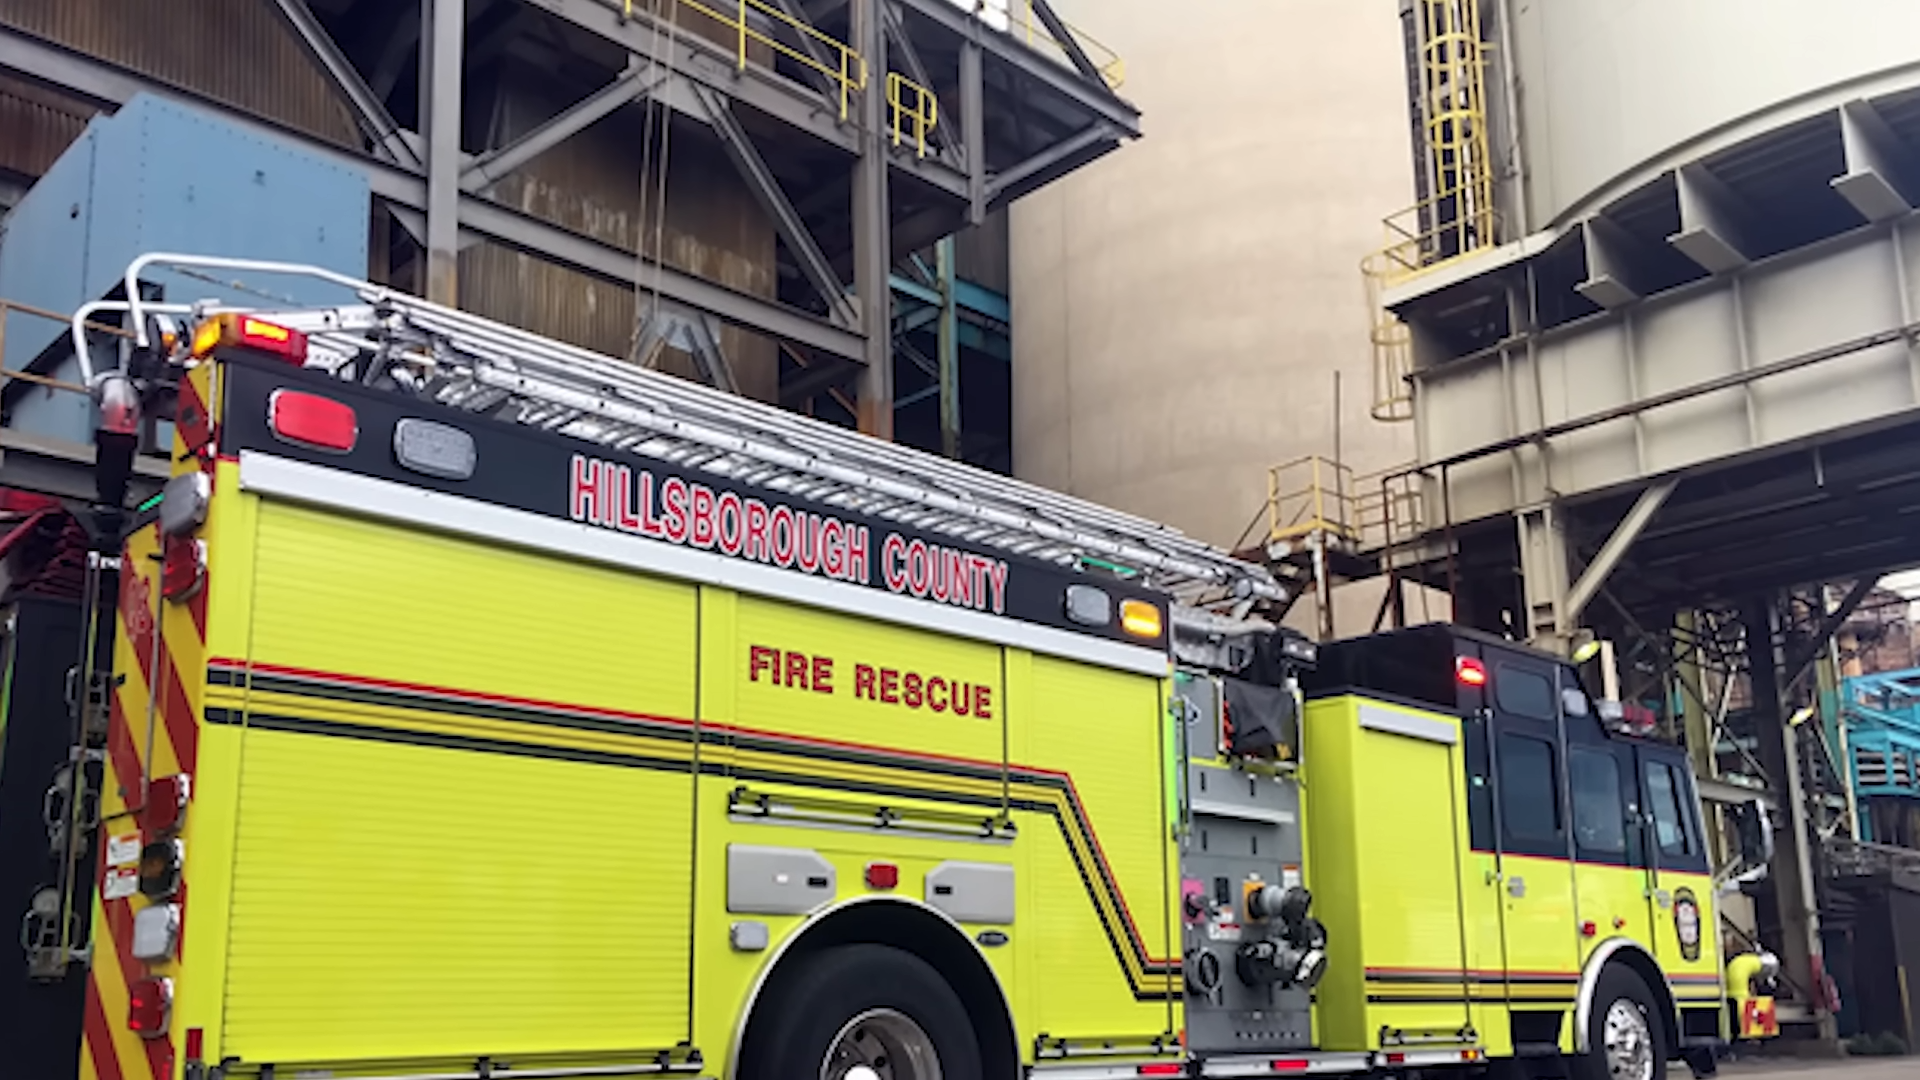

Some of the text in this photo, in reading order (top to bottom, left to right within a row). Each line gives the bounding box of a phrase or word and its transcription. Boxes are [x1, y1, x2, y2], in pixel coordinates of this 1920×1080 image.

[571, 455, 1008, 614] HILLSBOROUGH COUNTY
[749, 645, 993, 720] FIRE RESCUE
